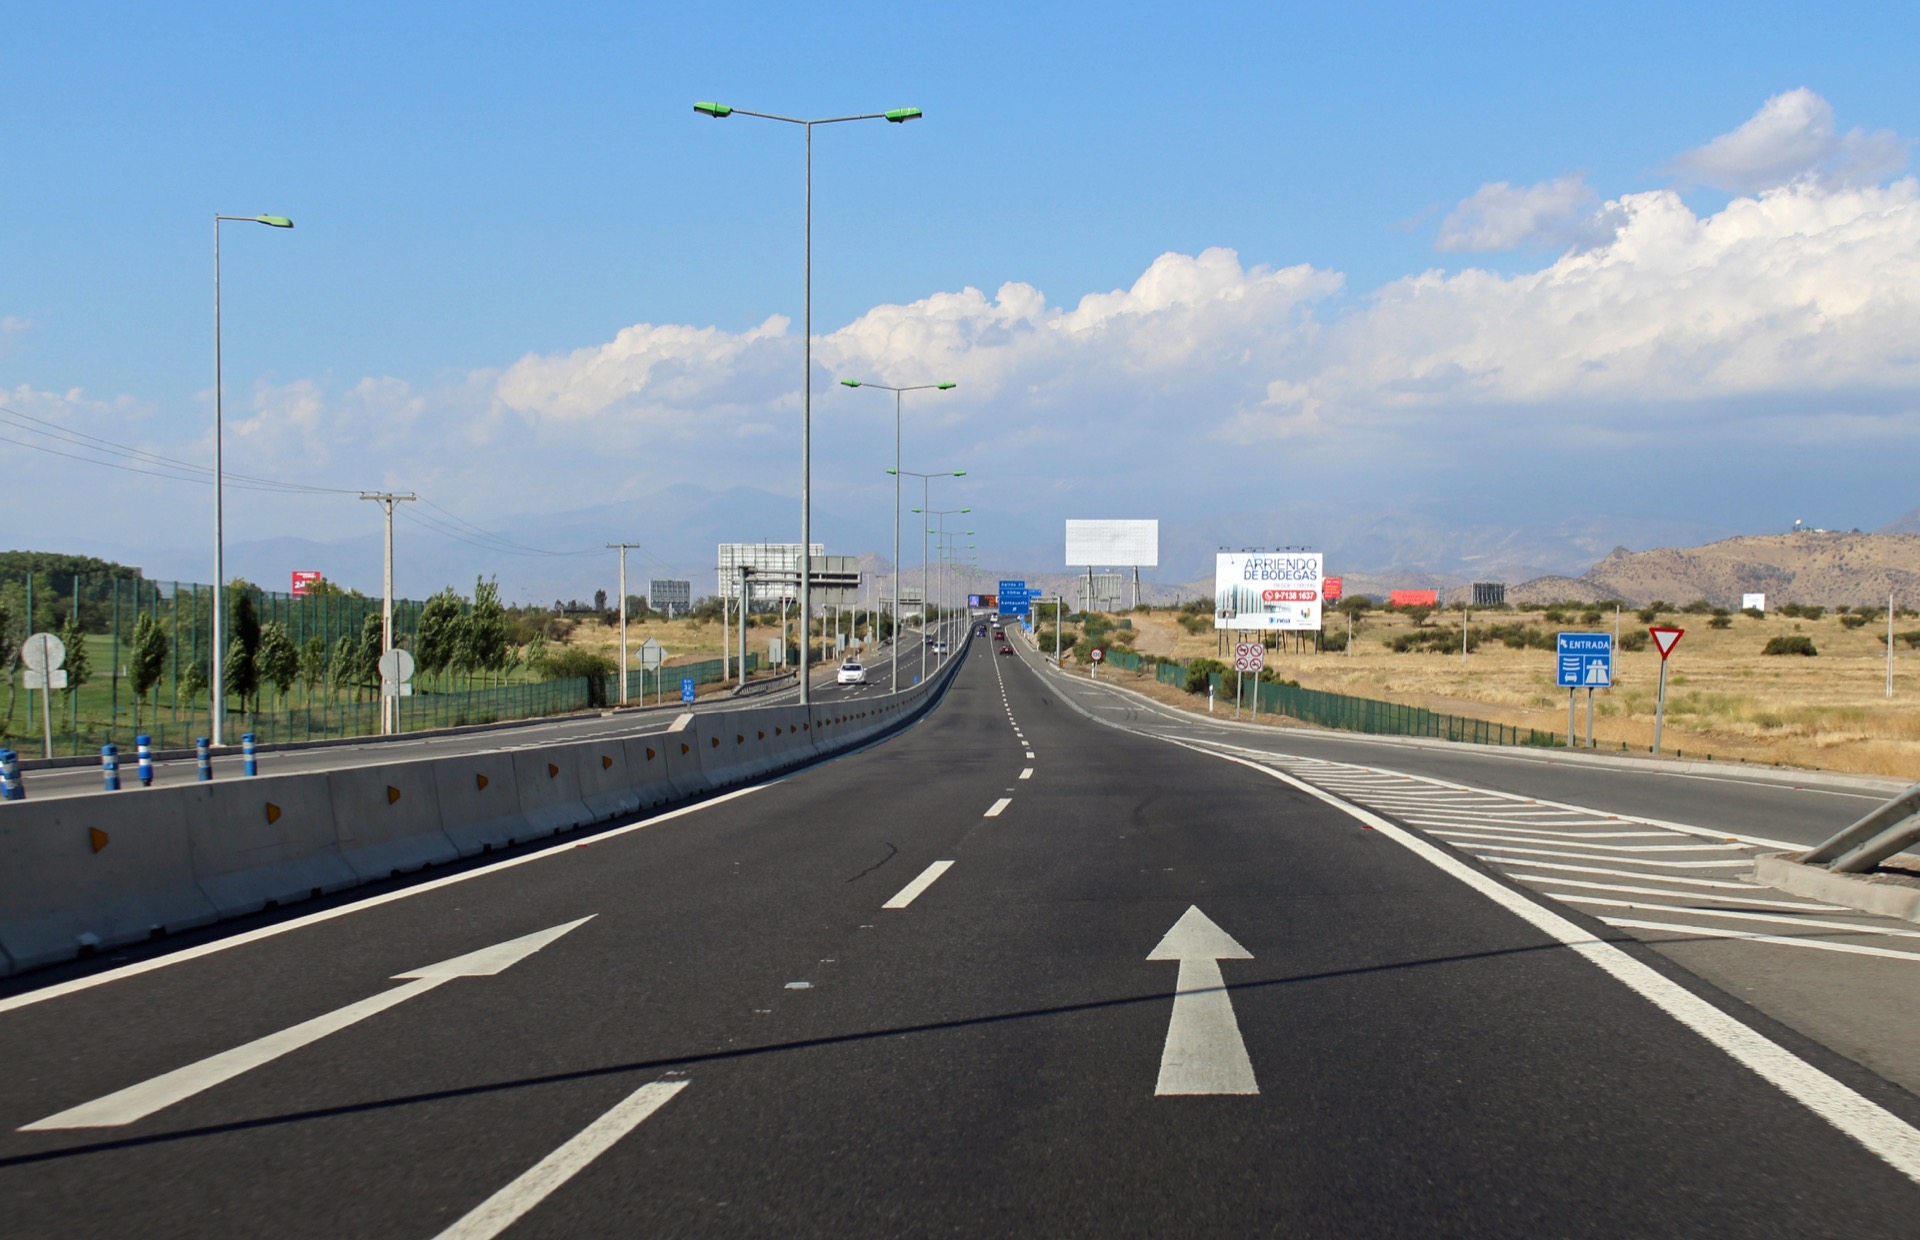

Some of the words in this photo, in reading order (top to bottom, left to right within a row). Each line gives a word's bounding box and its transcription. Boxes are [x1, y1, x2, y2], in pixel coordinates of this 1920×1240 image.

[1244, 558, 1317, 570] ARRIENDO
[1244, 570, 1259, 580] DE
[1262, 570, 1317, 580] BODEGAS
[1274, 591, 1297, 599] 9-7138
[1299, 591, 1314, 599] 1637
[1569, 640, 1609, 649] ENTRADA
